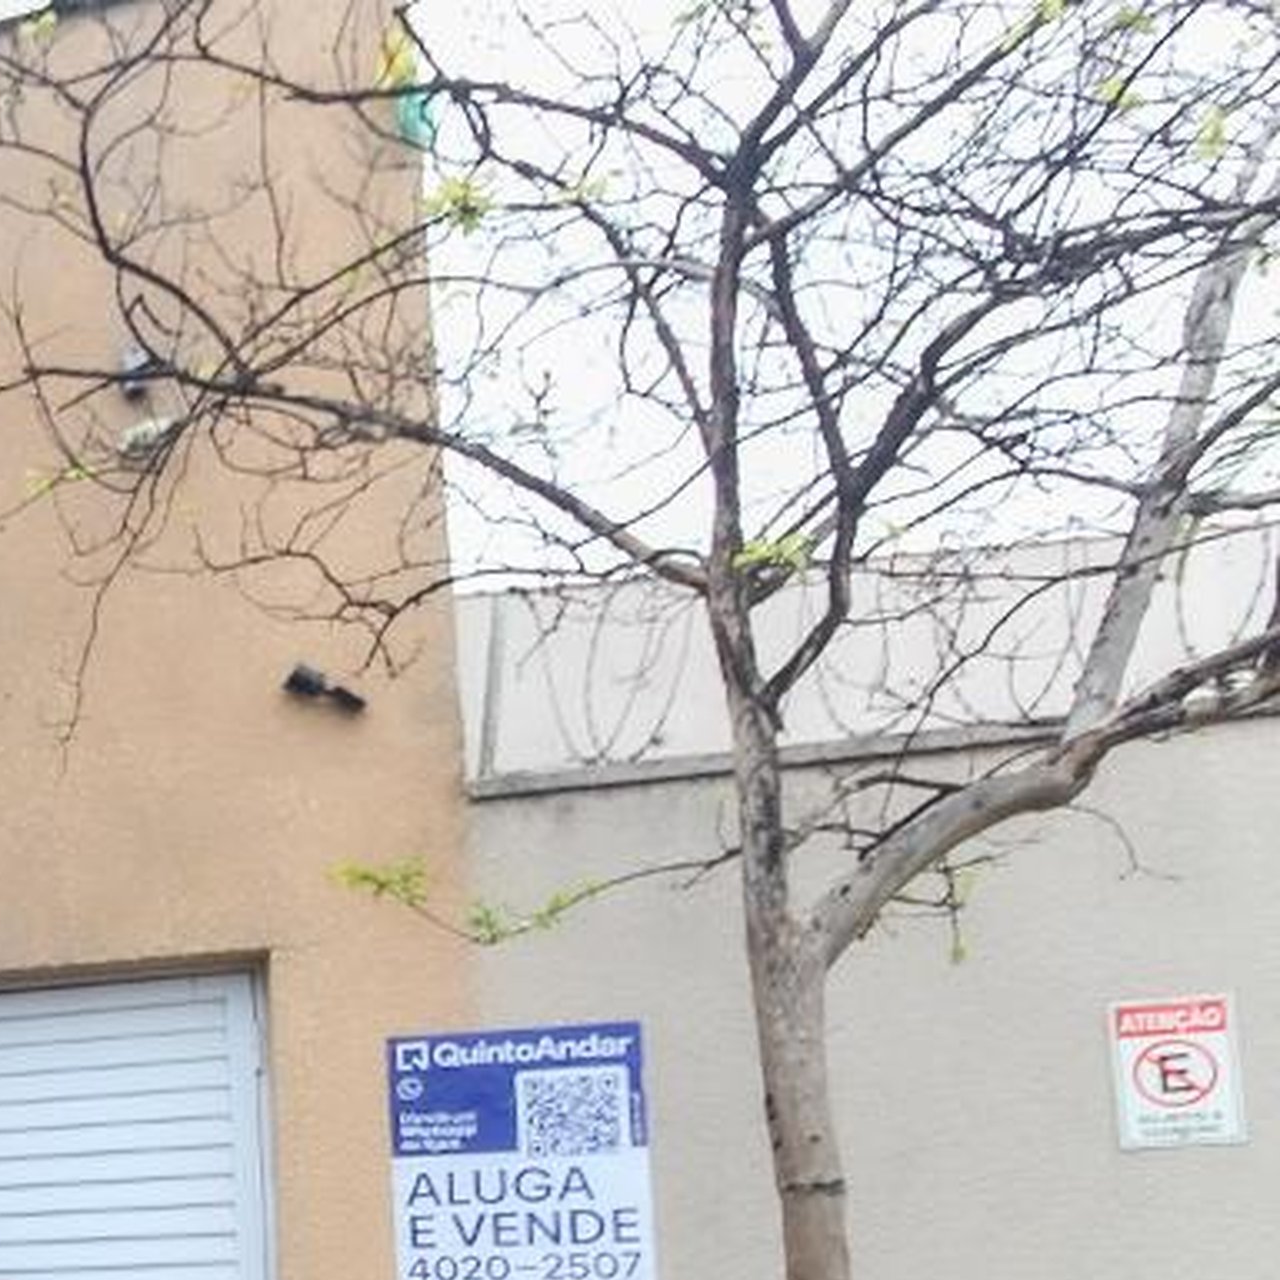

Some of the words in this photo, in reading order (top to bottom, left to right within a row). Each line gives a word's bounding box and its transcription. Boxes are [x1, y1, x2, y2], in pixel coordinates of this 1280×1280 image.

[433, 1033, 634, 1067] QuintoAndar
[407, 1166, 595, 1206] ALUGA
[408, 1214, 436, 1249] E
[452, 1207, 641, 1247] VENDE
